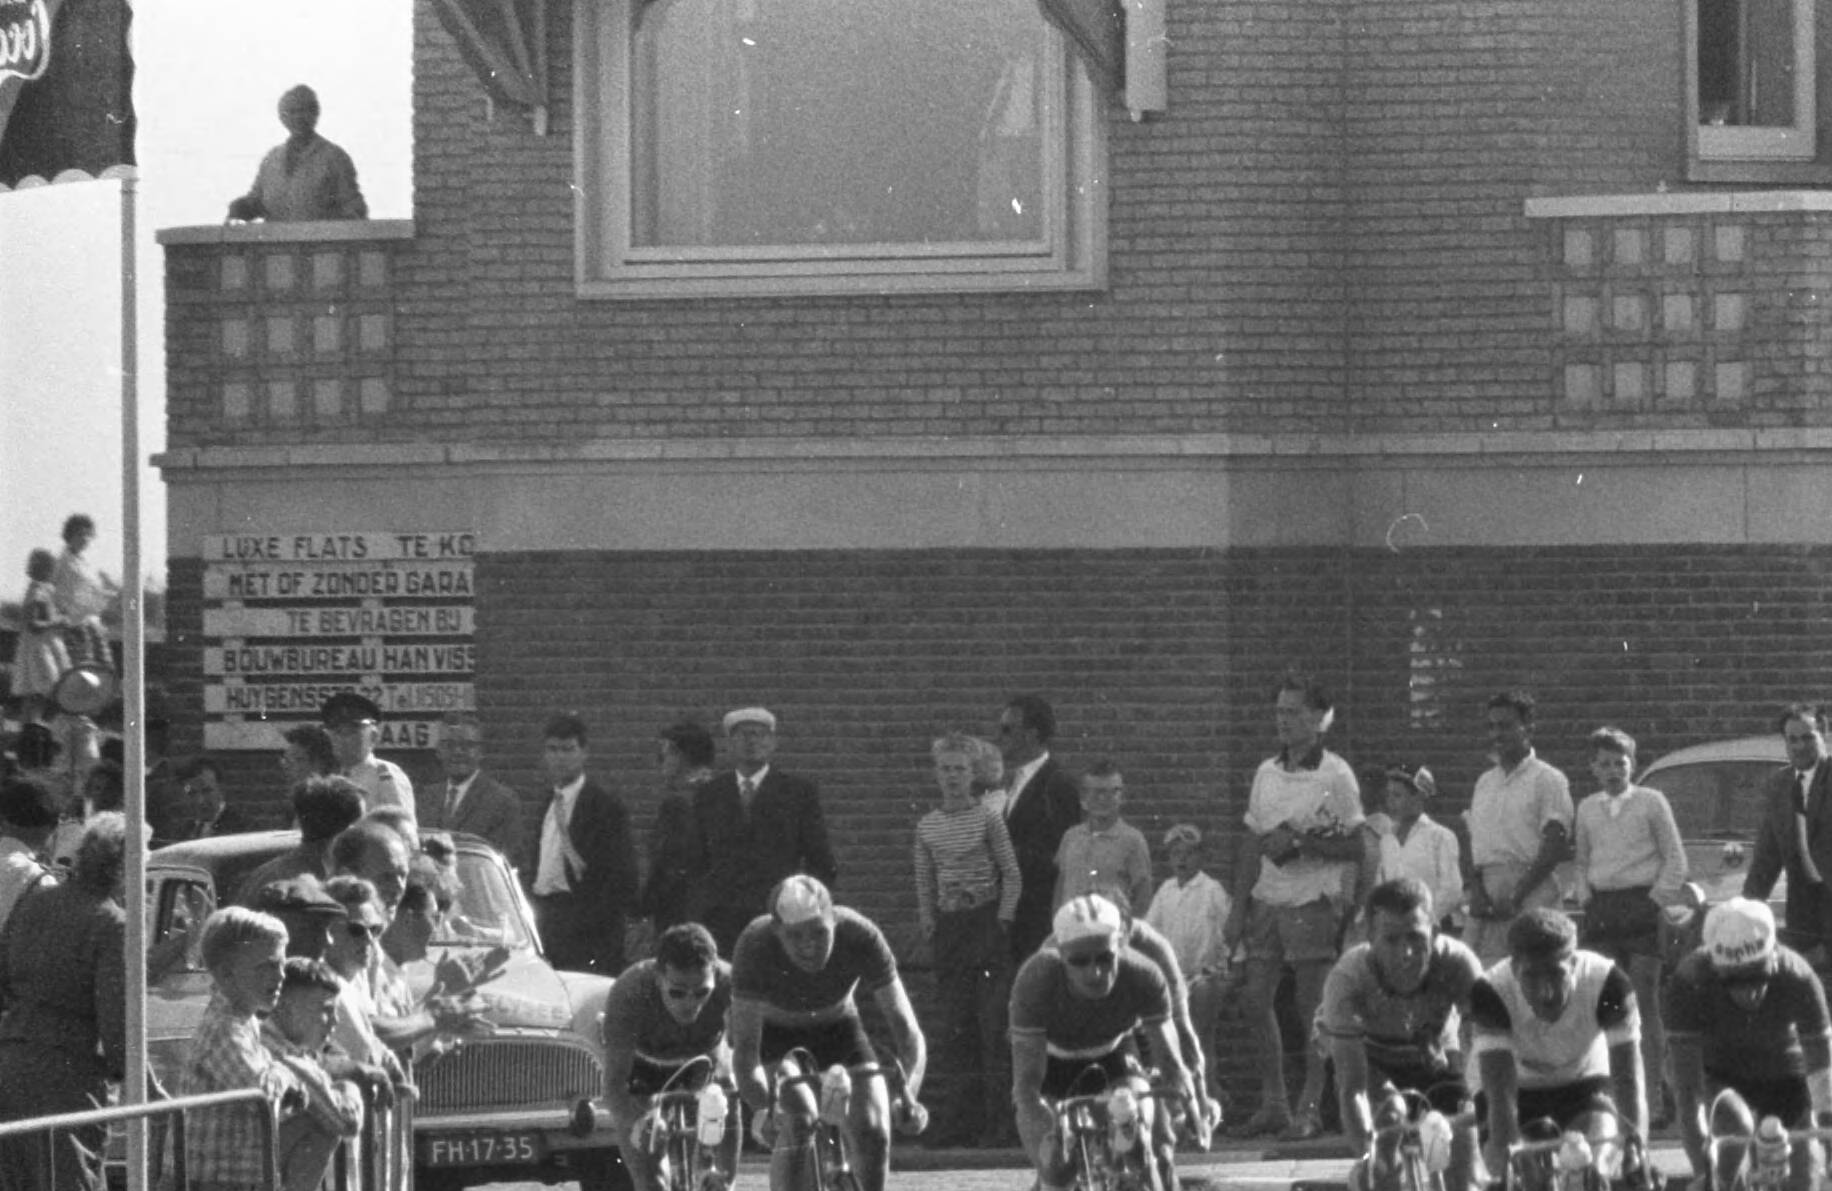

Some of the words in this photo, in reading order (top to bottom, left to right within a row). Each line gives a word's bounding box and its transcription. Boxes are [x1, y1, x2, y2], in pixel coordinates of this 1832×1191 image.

[222, 536, 281, 558] LUXE
[294, 535, 368, 558] FLATS
[395, 535, 428, 557] TE
[229, 572, 270, 596] MET
[278, 572, 304, 595] OF
[312, 571, 398, 595] ZONDER
[405, 571, 469, 594] GARA
[287, 610, 311, 633] TE
[319, 609, 430, 633] BEVRAGEN
[223, 648, 377, 673] BOUWBUREAU
[383, 647, 429, 671] HAN
[379, 724, 430, 747] AAG
